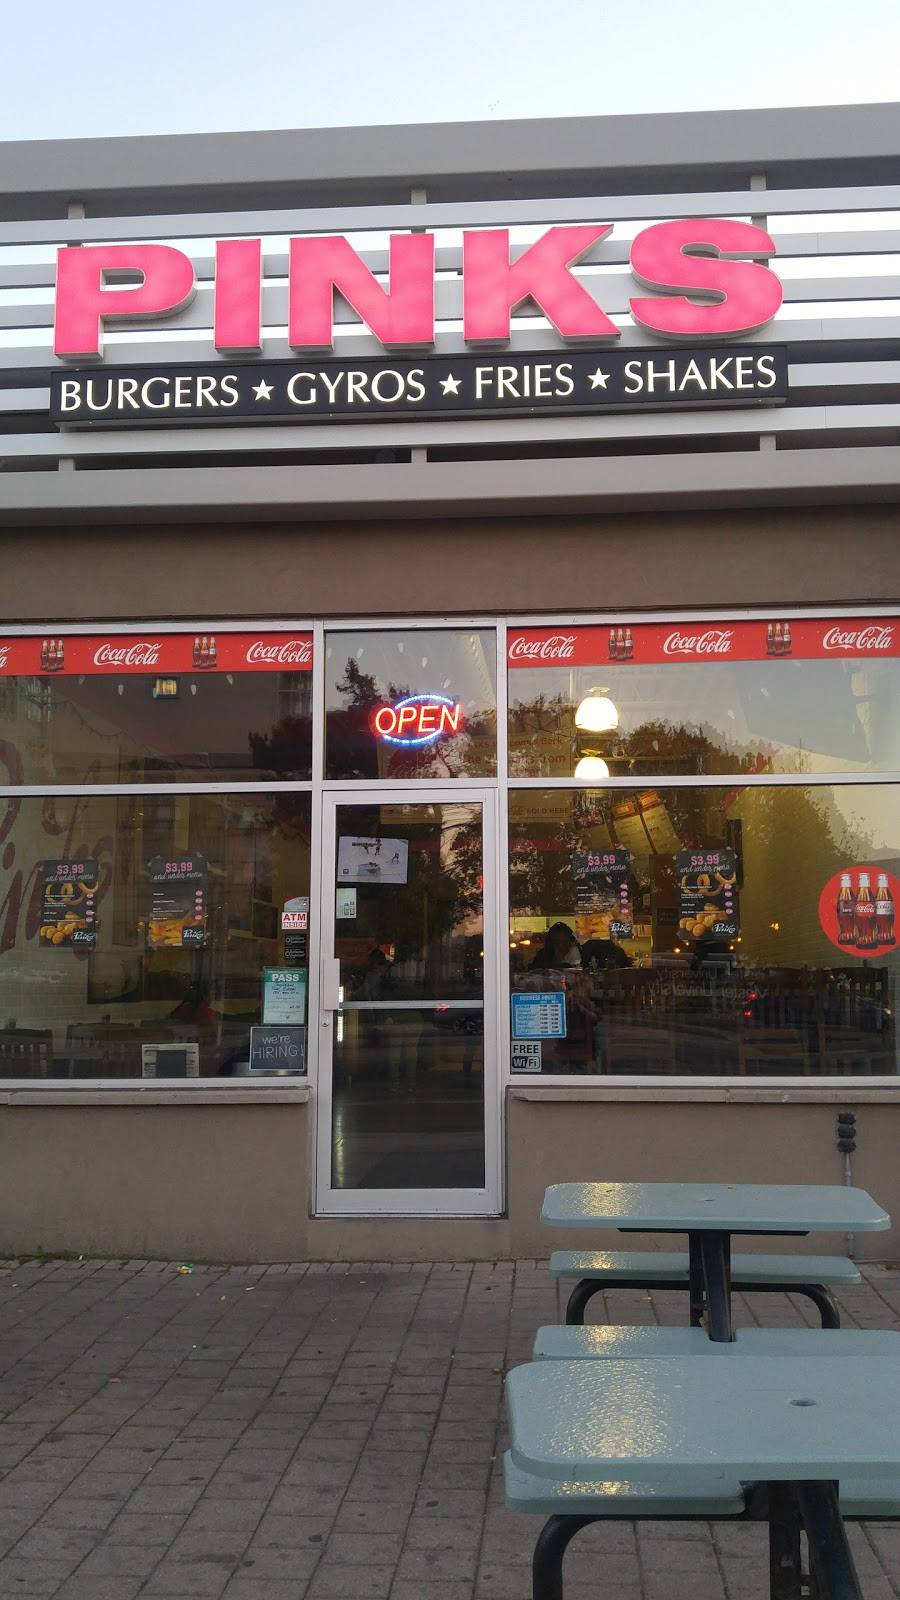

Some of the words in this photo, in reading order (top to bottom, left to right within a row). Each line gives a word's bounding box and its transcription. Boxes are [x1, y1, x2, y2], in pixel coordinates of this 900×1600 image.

[54, 217, 784, 358] PINKS
[60, 375, 239, 412] BURGERS
[287, 369, 426, 405] GYROS
[475, 363, 575, 399] FRIES
[624, 355, 777, 394] SHAKES
[375, 703, 460, 734] OPEN
[587, 854, 616, 866] $3.99
[690, 854, 720, 866] $3.99
[56, 863, 84, 876] $3.99
[165, 862, 193, 873] $3.99
[283, 913, 306, 921] ATM
[272, 973, 300, 982] PASS
[262, 1034, 291, 1044] we're
[252, 1043, 304, 1060] HIRING!
[513, 1044, 540, 1054] FREE
